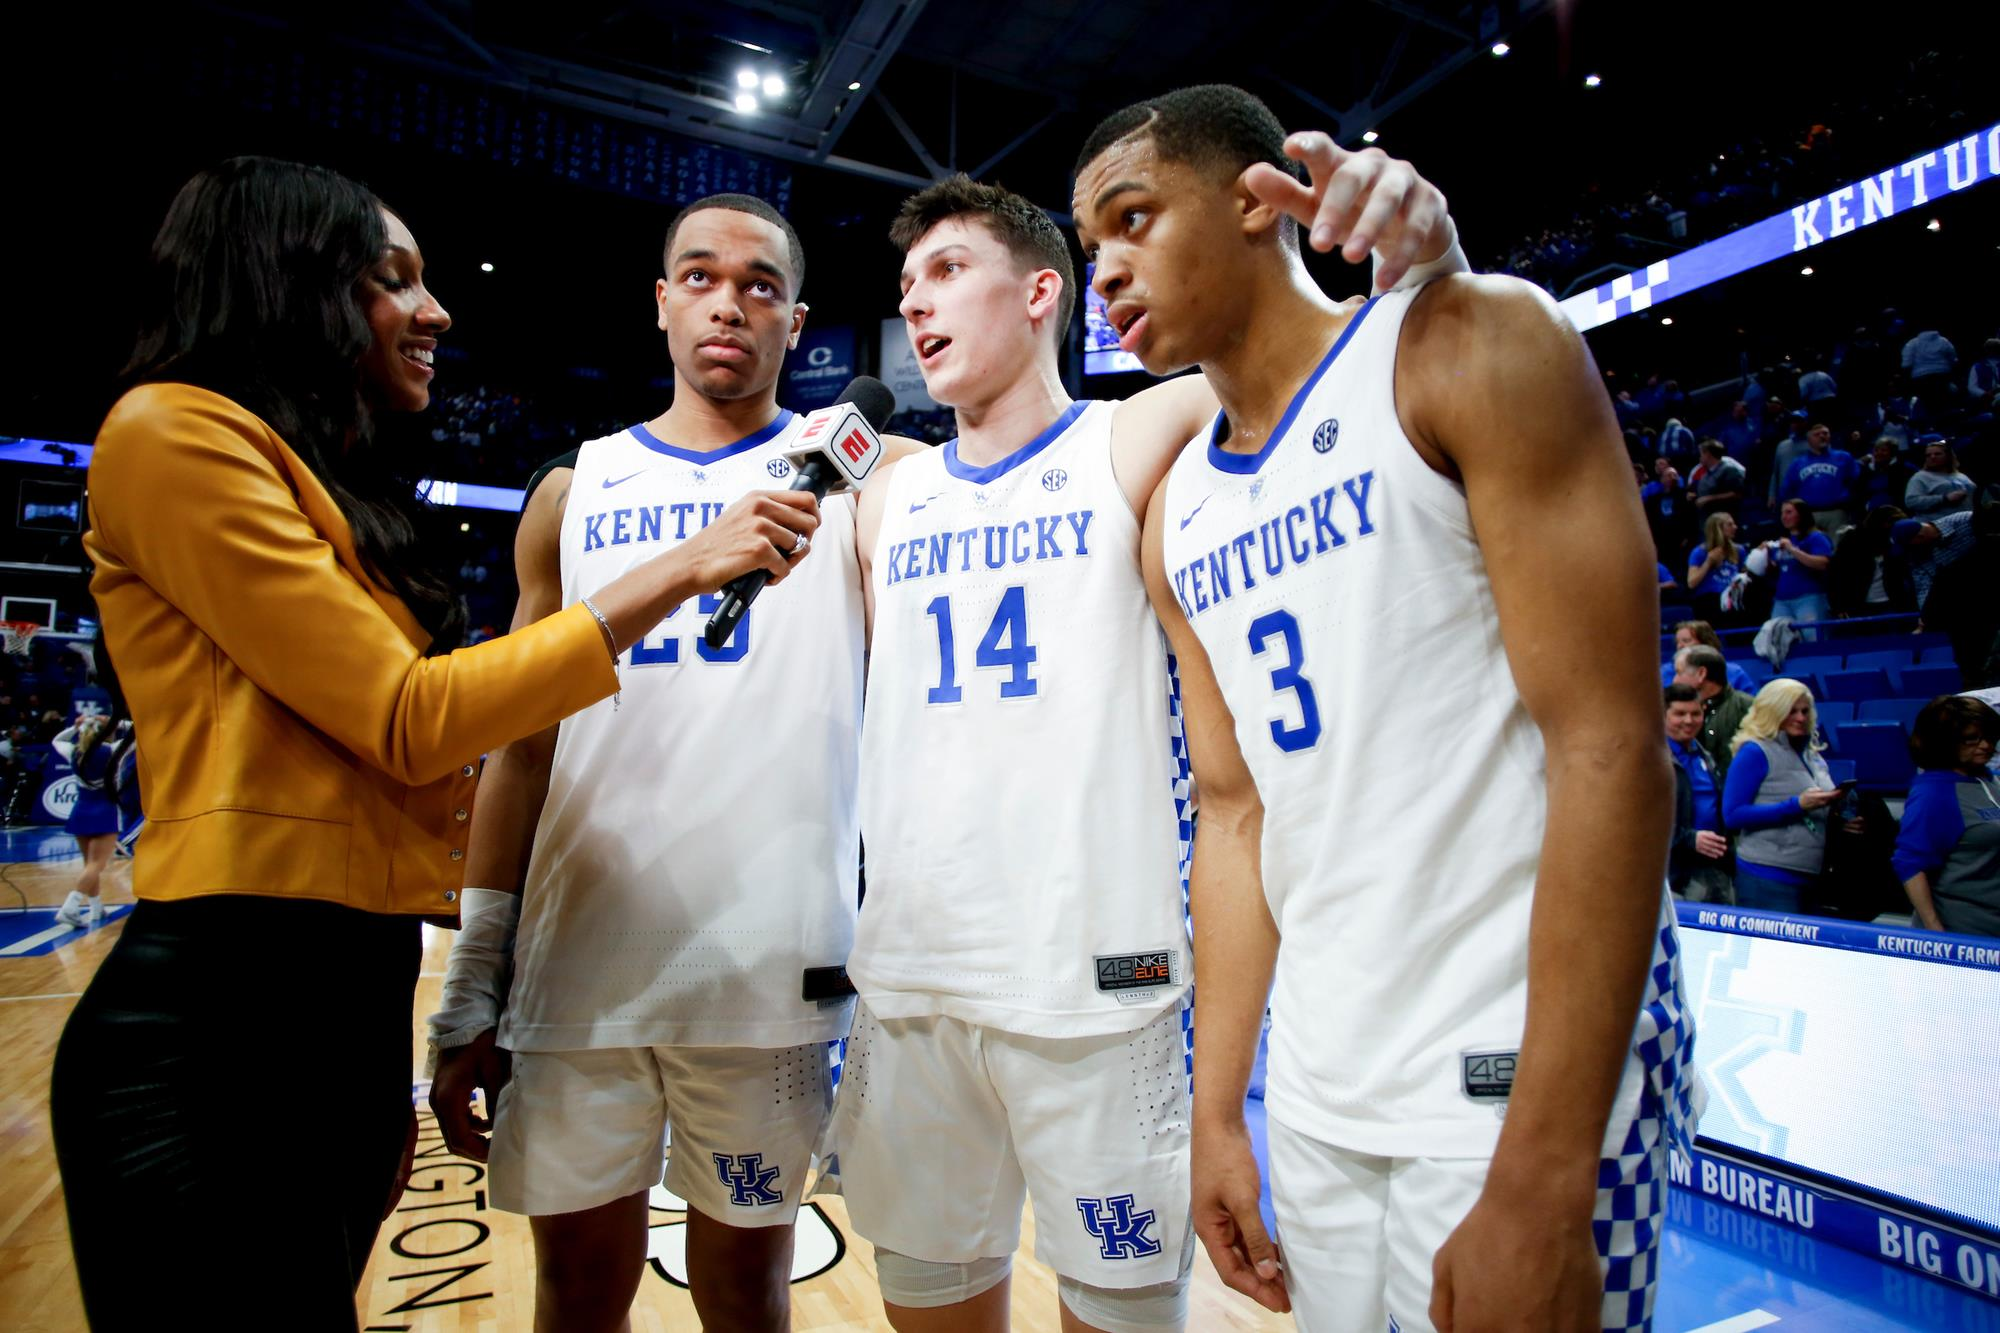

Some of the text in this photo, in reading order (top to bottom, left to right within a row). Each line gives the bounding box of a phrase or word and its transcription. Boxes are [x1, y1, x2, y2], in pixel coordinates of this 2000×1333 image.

[643, 136, 657, 183] NCAA
[1313, 419, 1339, 454] SEC
[767, 459, 790, 478] SEC
[1042, 468, 1067, 491] SEC
[887, 509, 1094, 586] KENTUCKY
[1174, 470, 1377, 620] KENTUCKY
[926, 586, 1038, 704] 14
[1247, 608, 1323, 753] 3
[1698, 910, 1820, 940] BIG ON COMMITMENT
[1101, 960, 1134, 978] 48
[1135, 954, 1167, 967] NIKE
[1878, 935, 2000, 965] KENTUCKY FARM
[1469, 1057, 1516, 1082] 48
[712, 1152, 784, 1206] UK
[1667, 1149, 1692, 1187] M
[1701, 1159, 1814, 1229] BUREAU
[1076, 1193, 1161, 1260] UK
[1879, 1216, 1942, 1275] BIG
